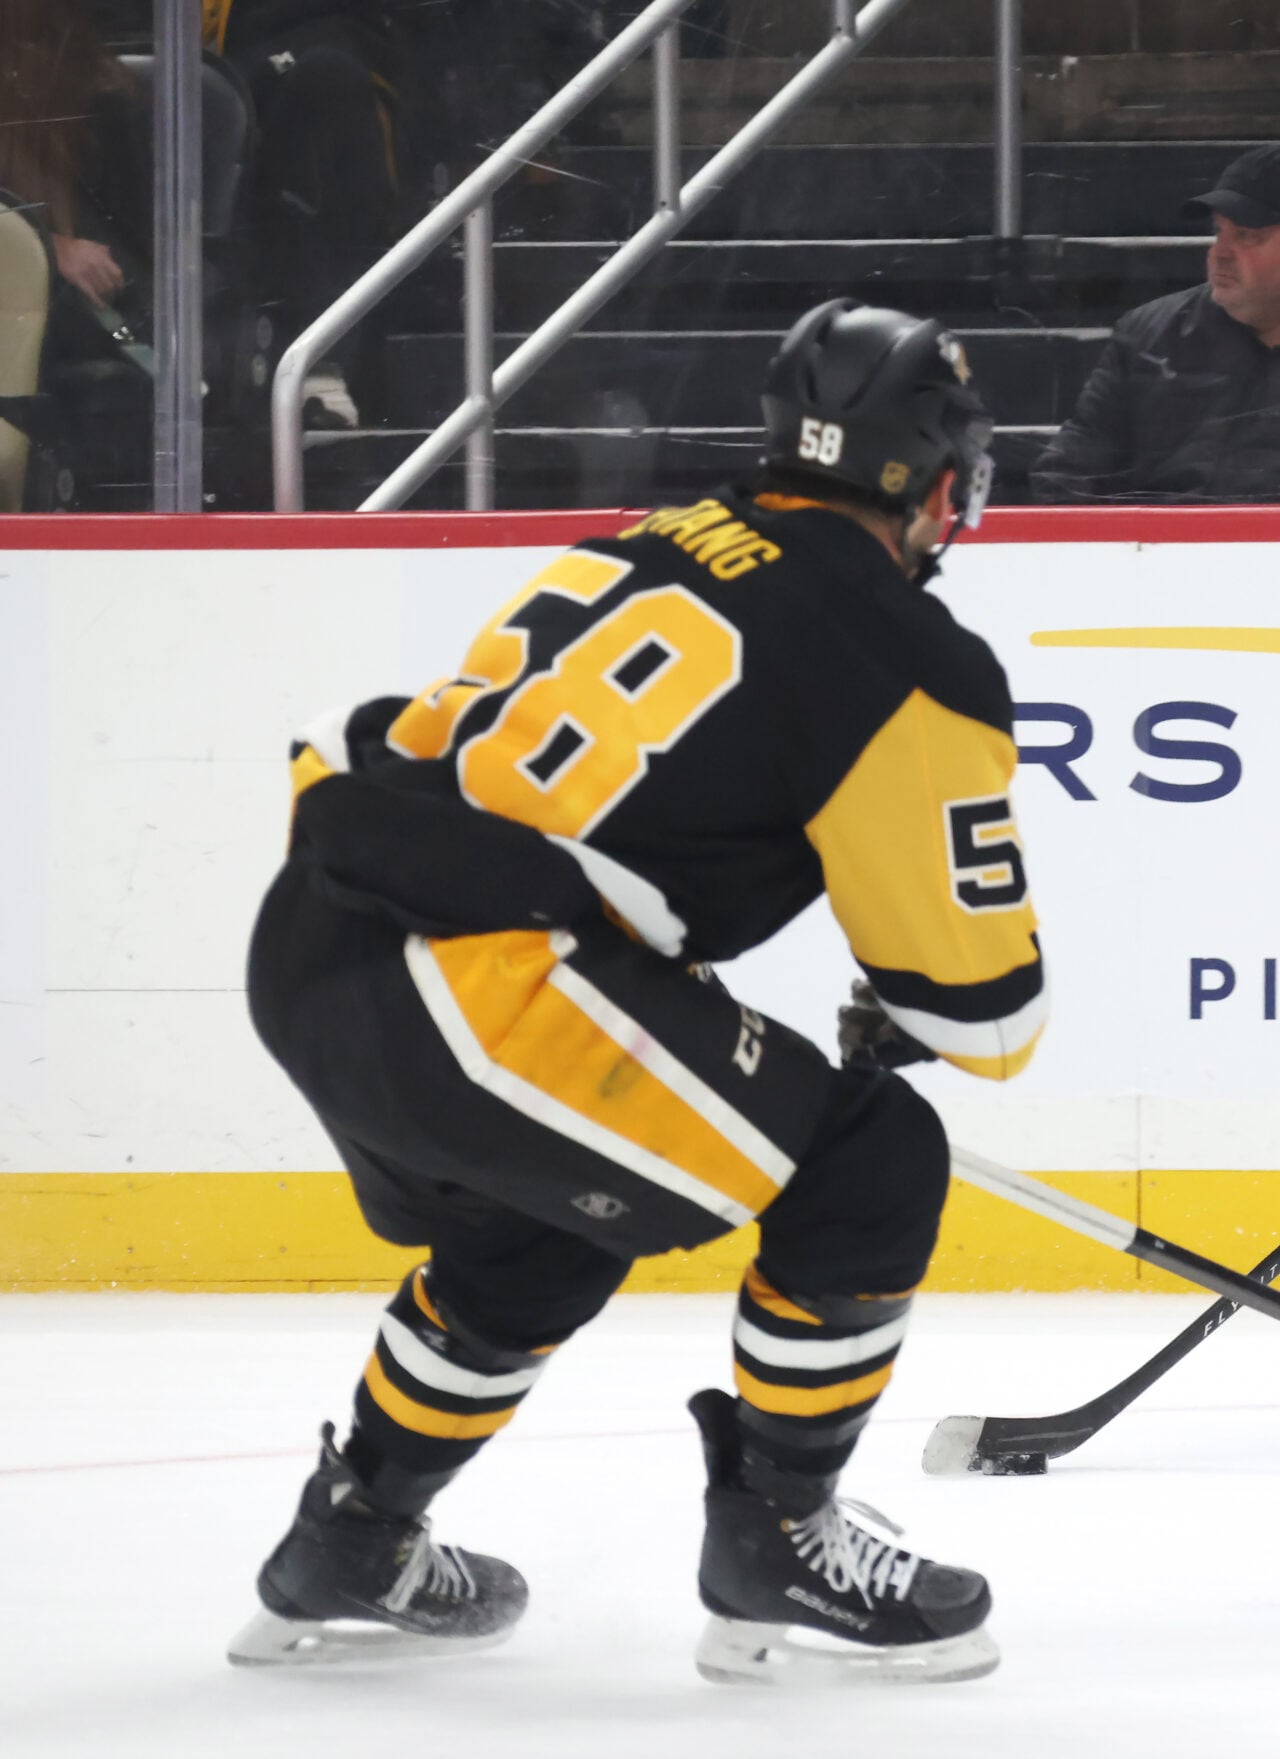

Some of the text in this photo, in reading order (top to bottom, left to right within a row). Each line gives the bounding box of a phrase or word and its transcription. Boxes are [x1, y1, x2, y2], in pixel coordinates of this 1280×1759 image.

[798, 416, 844, 466] 58
[386, 549, 743, 843] 58
[1012, 700, 1242, 803] RS
[942, 791, 1030, 916] 5
